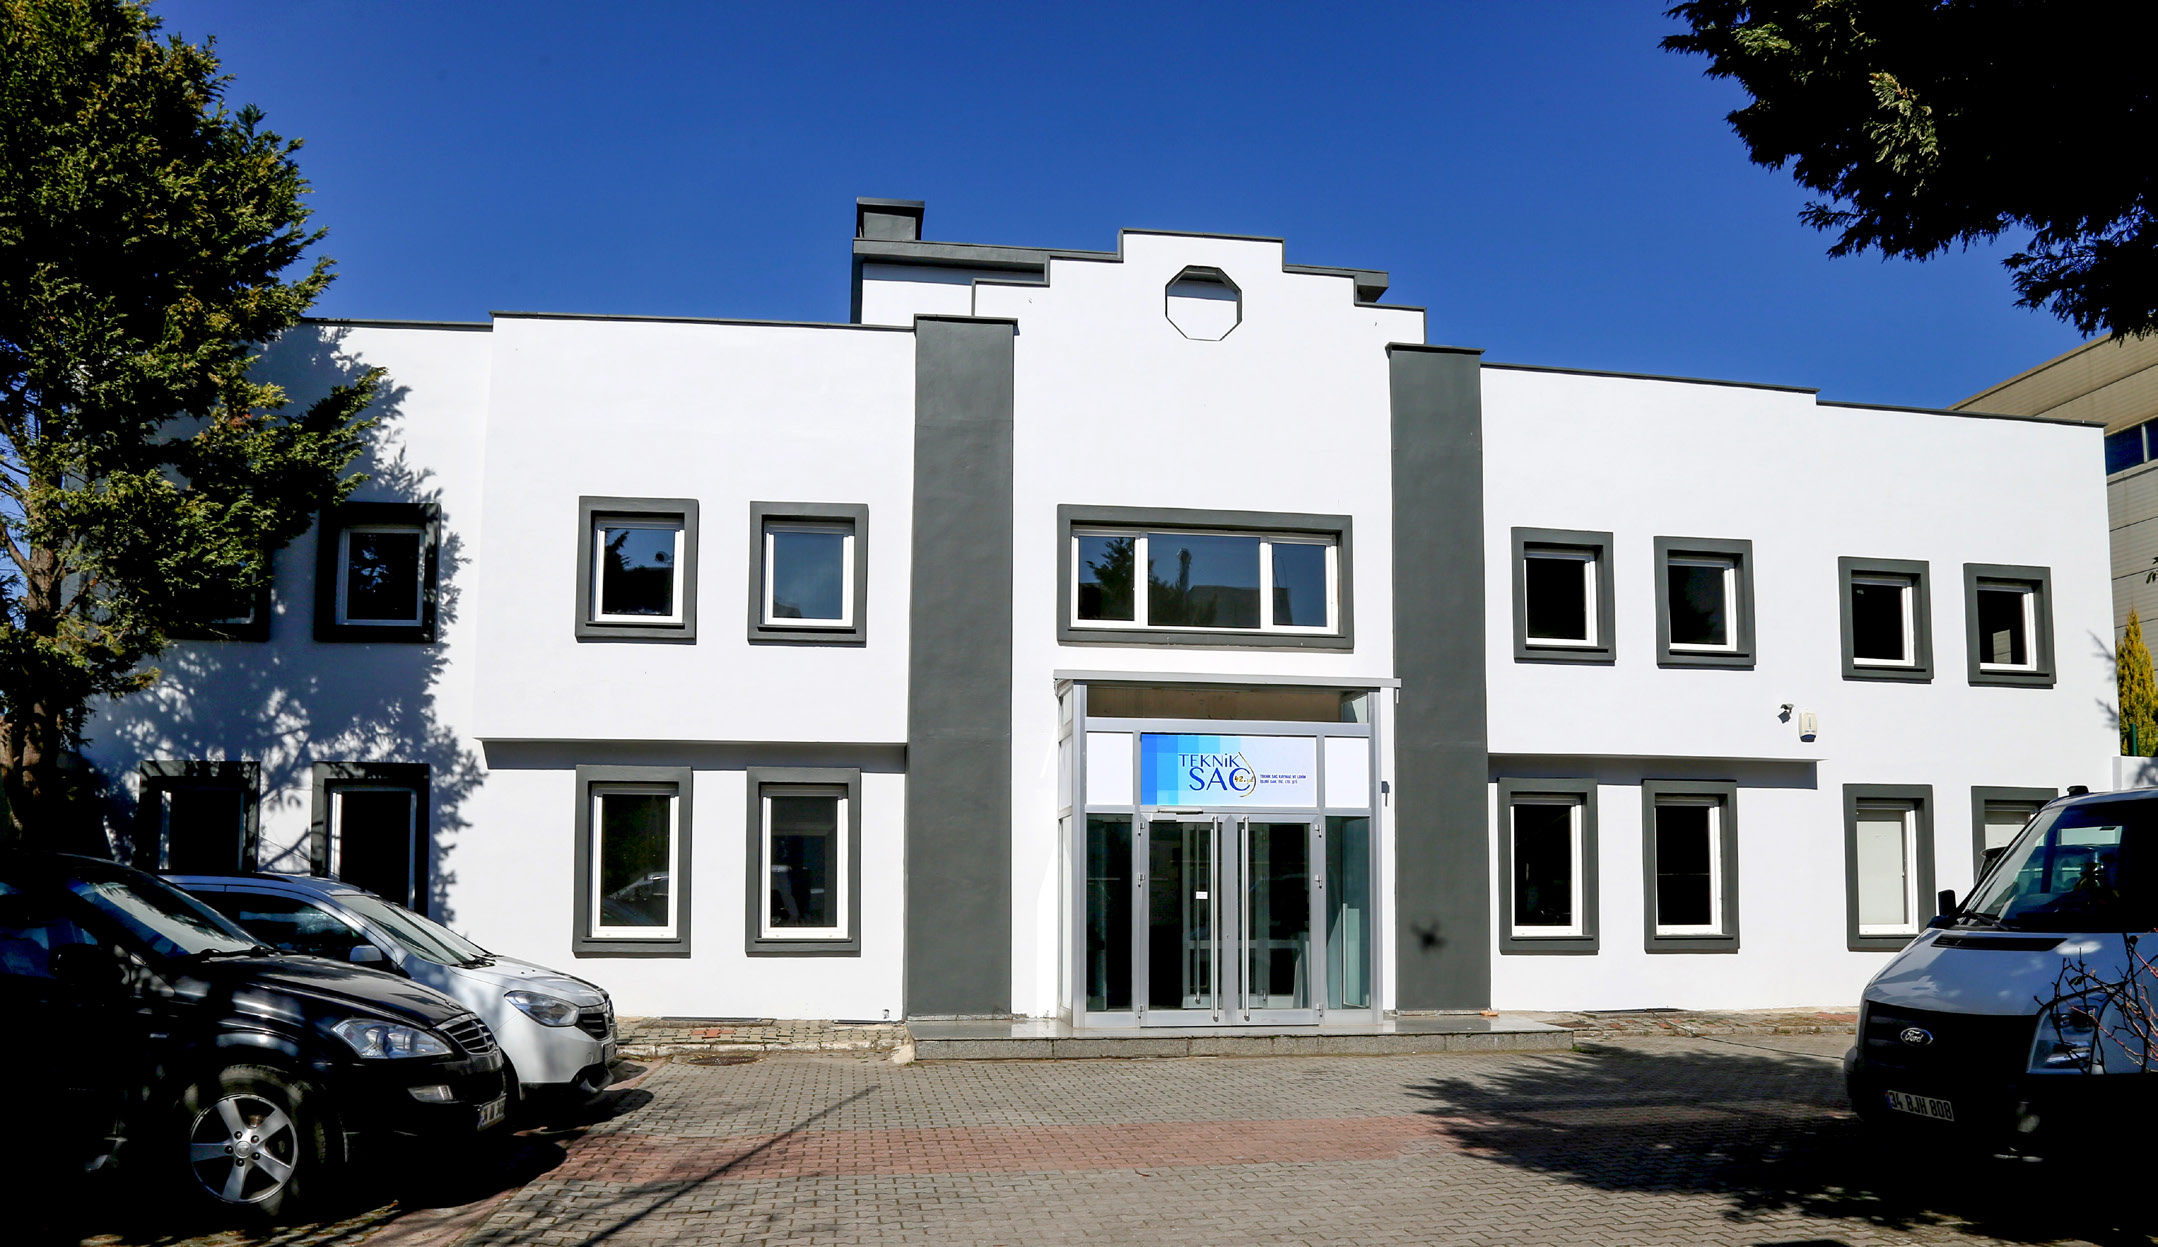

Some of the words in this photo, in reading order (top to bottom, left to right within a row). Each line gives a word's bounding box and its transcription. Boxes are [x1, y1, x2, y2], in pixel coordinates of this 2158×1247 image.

[1189, 767, 1251, 791] SAC
[1905, 1029, 1924, 1042] Ford
[1889, 1091, 1903, 1110] 34
[1904, 1094, 1928, 1115] BJH
[1929, 1099, 1952, 1119] 808
